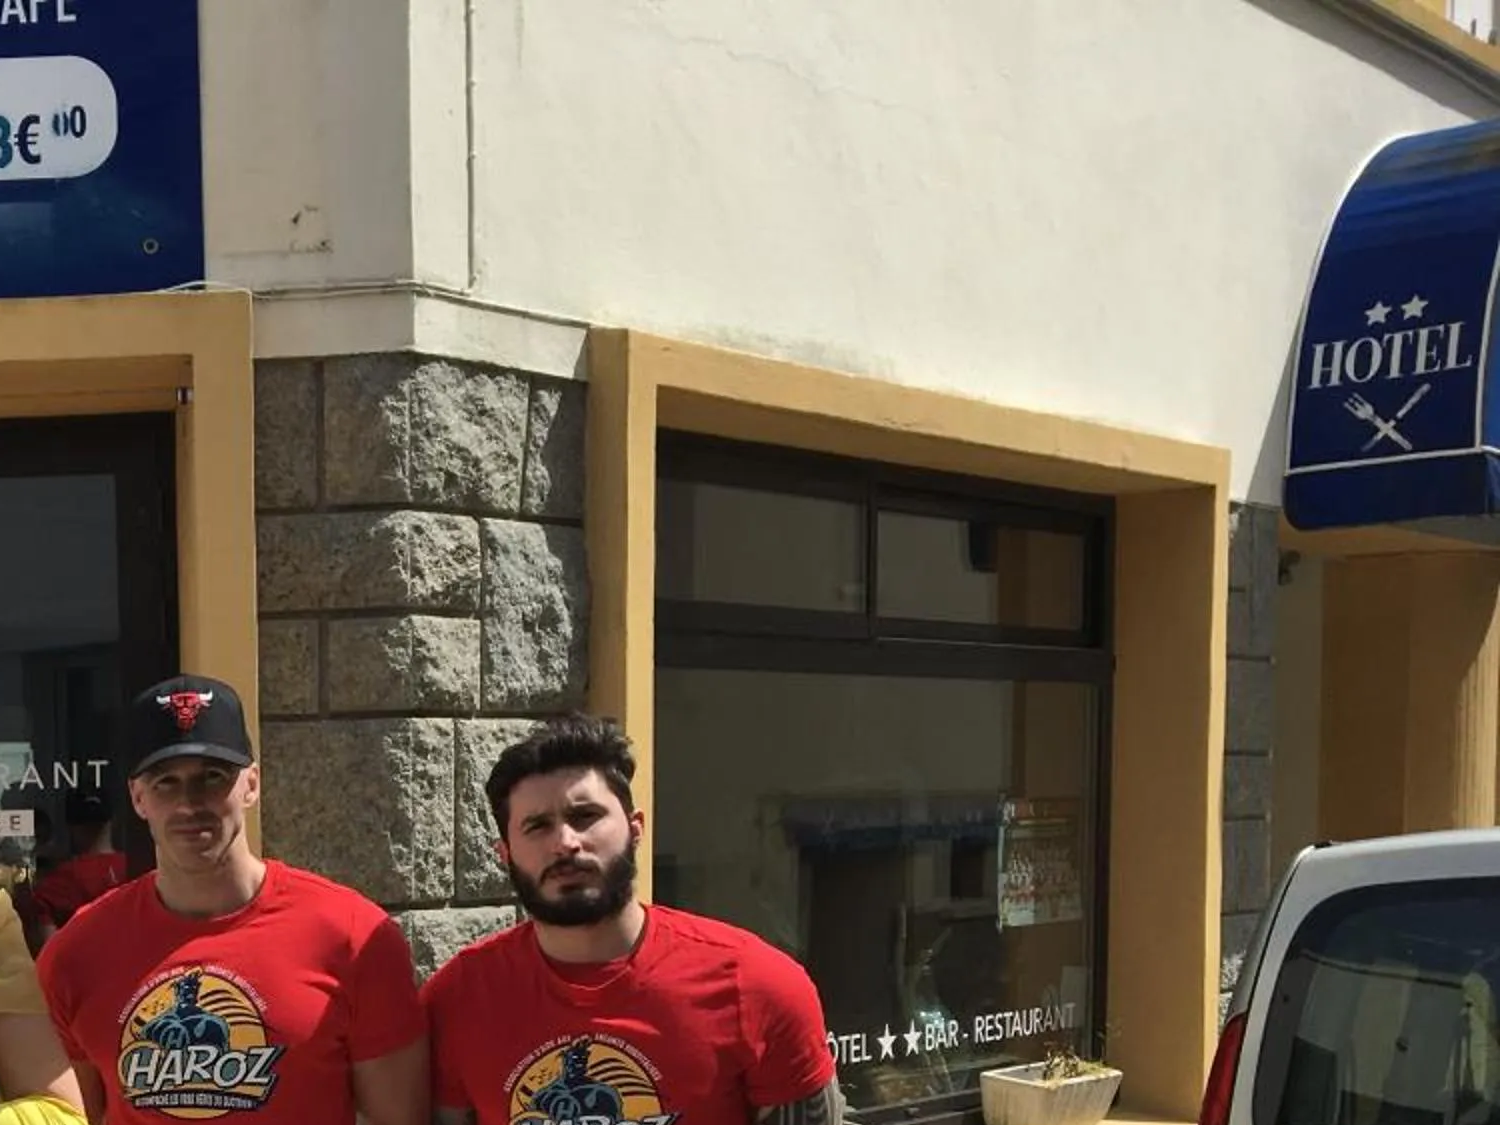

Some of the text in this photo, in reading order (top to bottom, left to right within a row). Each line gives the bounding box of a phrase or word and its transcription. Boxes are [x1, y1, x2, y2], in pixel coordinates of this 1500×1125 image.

[1308, 321, 1472, 390] HOTEL
[827, 1031, 872, 1066] ÔTEL
[925, 1020, 959, 1051] BAR
[975, 1003, 1076, 1045] RESTAURANT
[127, 1045, 275, 1092] HAROZ
